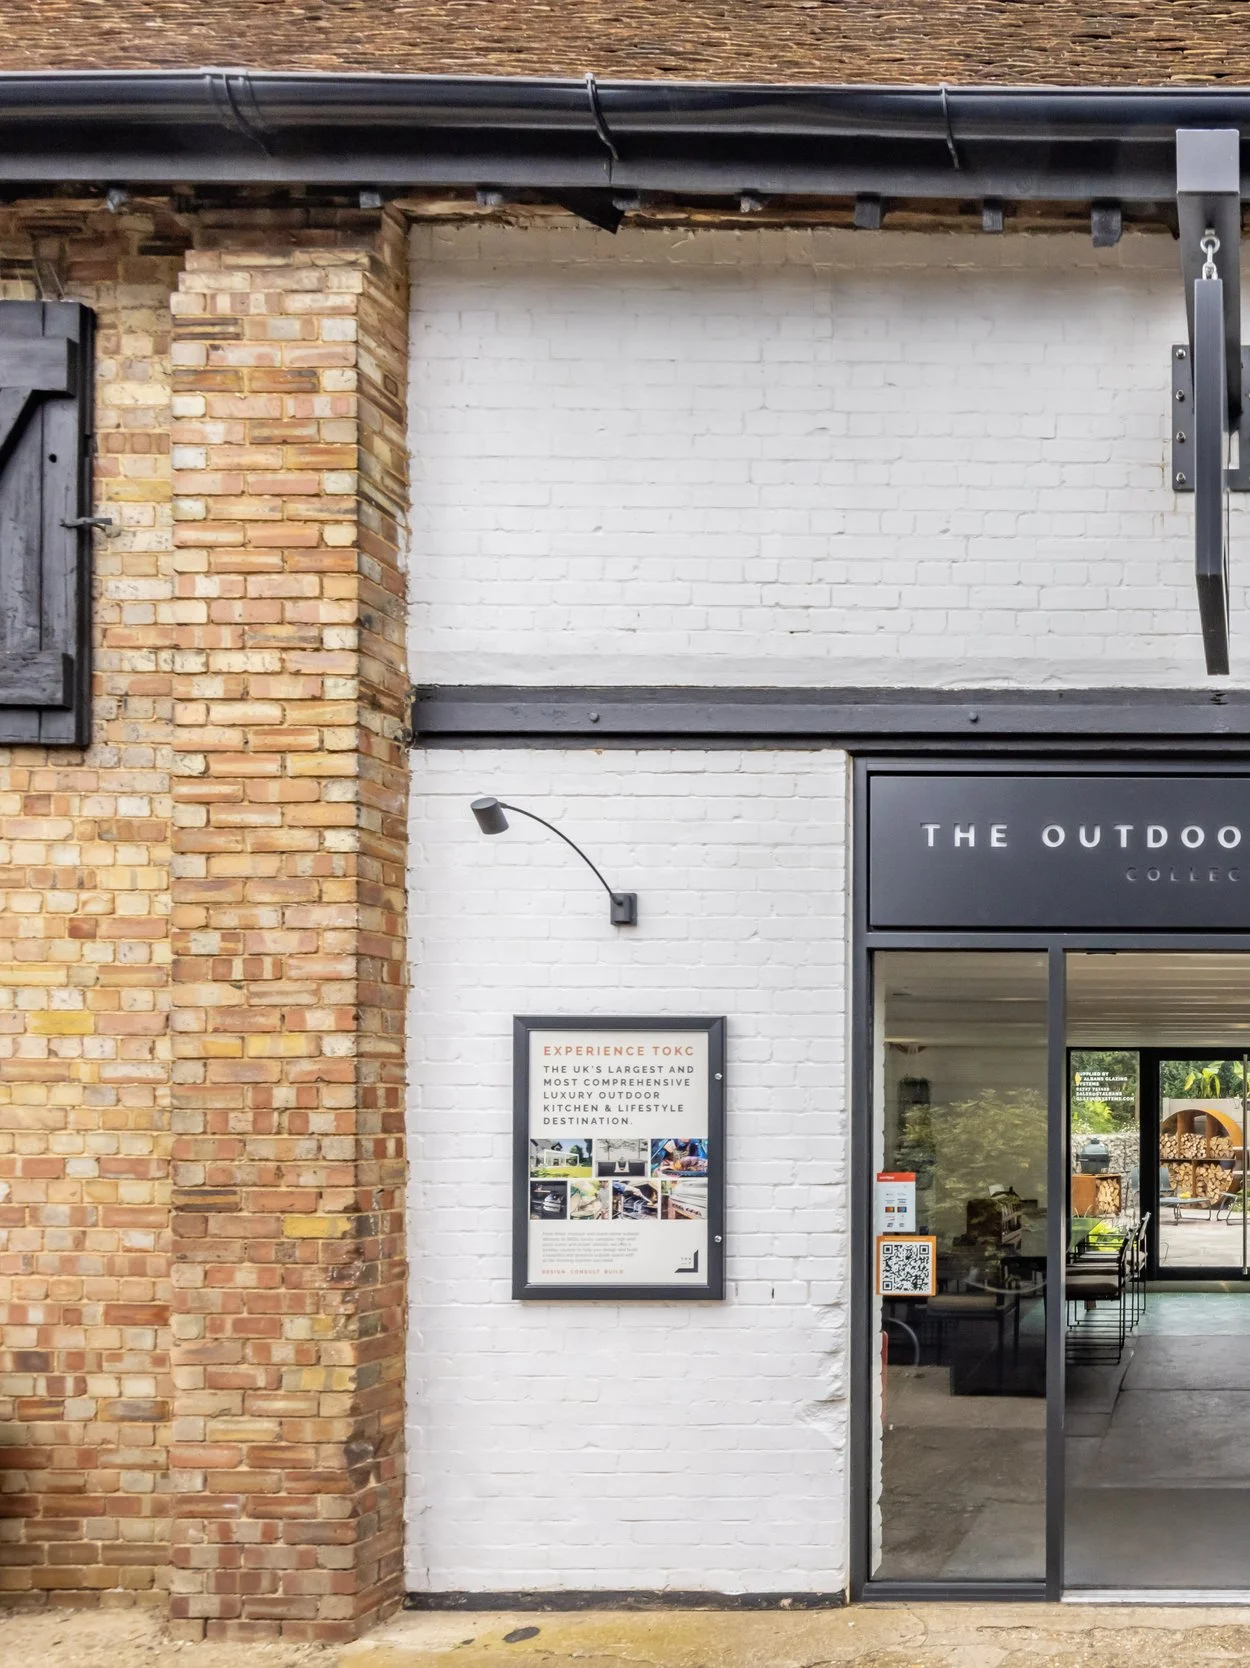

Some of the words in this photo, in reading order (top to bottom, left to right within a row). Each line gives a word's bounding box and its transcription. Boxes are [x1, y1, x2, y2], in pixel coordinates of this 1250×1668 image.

[920, 823, 1009, 848] THE
[543, 1046, 645, 1056] EXPERIENCE
[653, 1046, 695, 1056] TOKC
[543, 1066, 567, 1074] THE
[573, 1066, 603, 1074] UK'S
[608, 1066, 664, 1074] LARGEST
[669, 1066, 695, 1074] AND
[543, 1078, 578, 1086] MOST
[584, 1078, 691, 1087] COMPREHENSIVE
[543, 1091, 593, 1099] LUXURY
[599, 1091, 661, 1099] OUTDOOR
[543, 1104, 599, 1112] KITCHEN
[605, 1104, 612, 1112] &
[618, 1104, 684, 1112] LIFESTYLE
[543, 1117, 633, 1125] DESTINATION.
